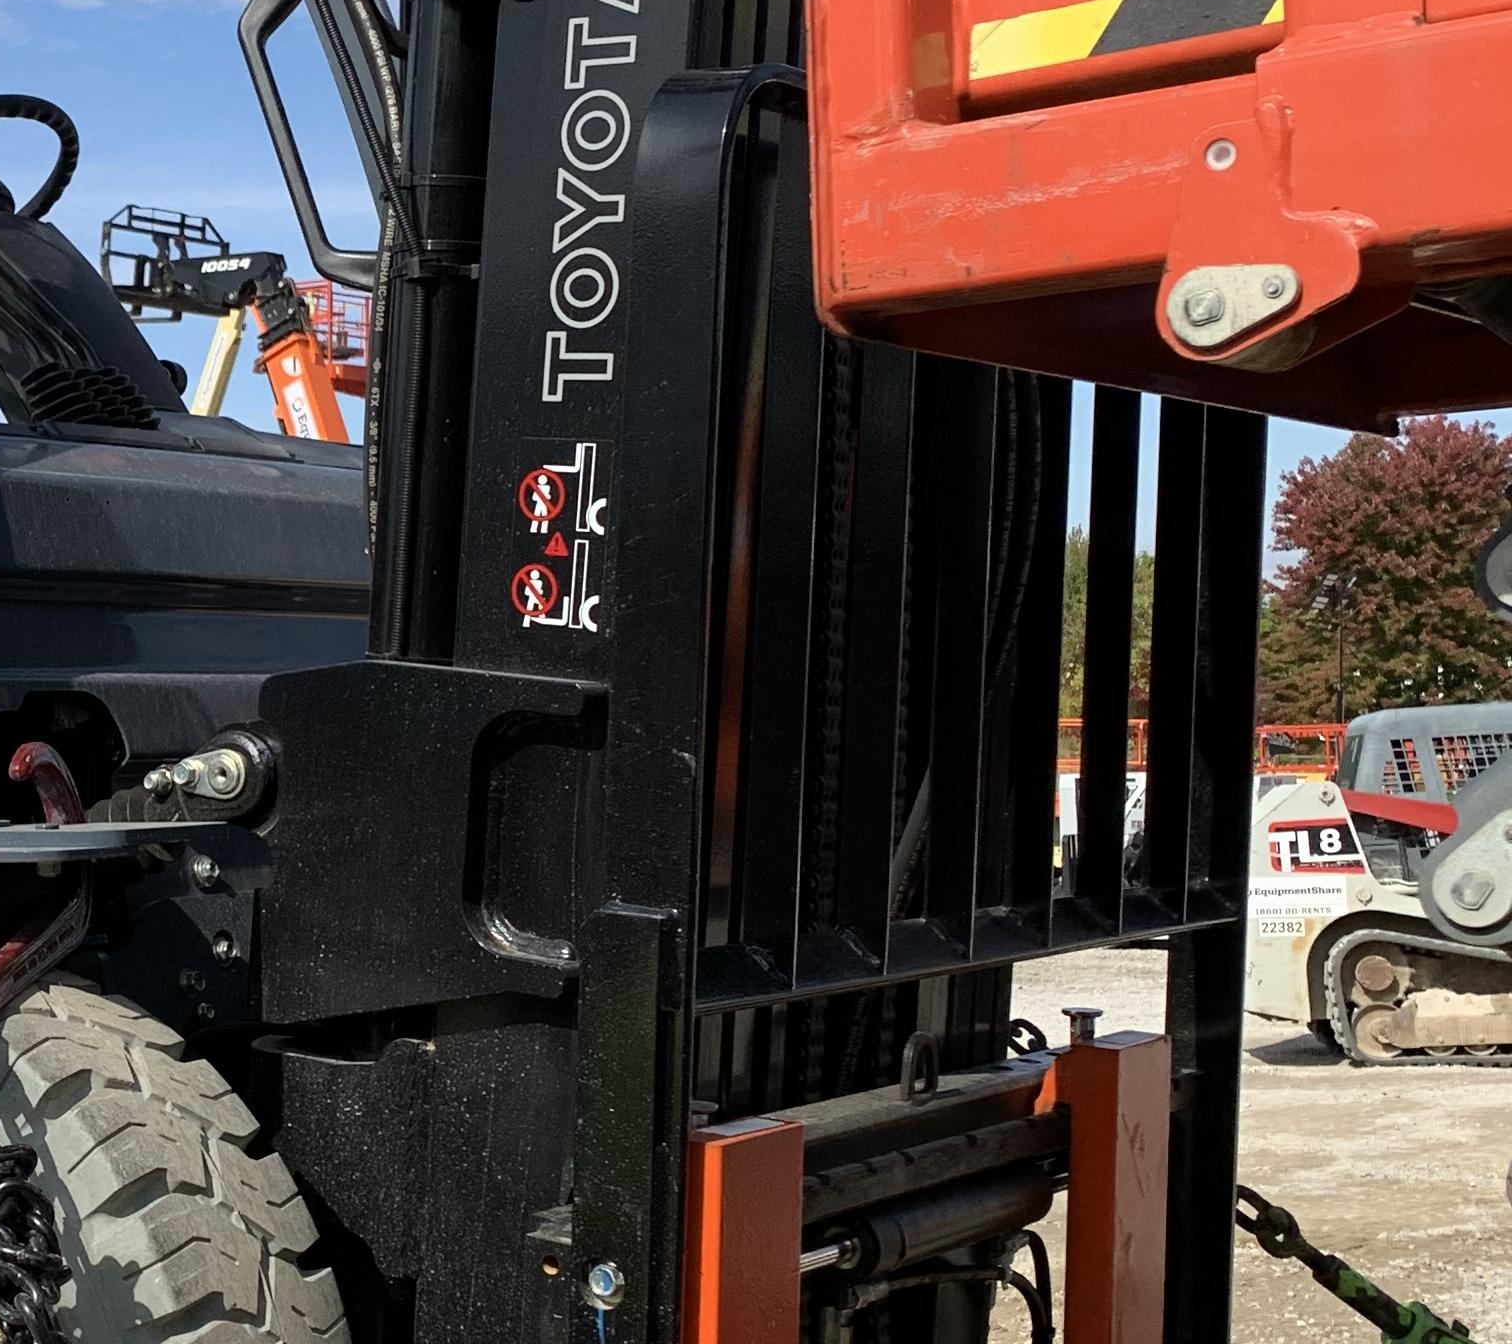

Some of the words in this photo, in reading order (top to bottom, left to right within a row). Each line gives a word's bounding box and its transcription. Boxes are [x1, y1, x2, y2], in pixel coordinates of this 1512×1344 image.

[383, 217, 395, 246] WIRE
[201, 257, 253, 273] 10054
[379, 251, 392, 283] MSHA
[374, 285, 388, 332] IC-101/34
[1268, 828, 1342, 873] TL8
[1255, 886, 1342, 897] EquipmentShare
[1261, 921, 1303, 934] 22382
